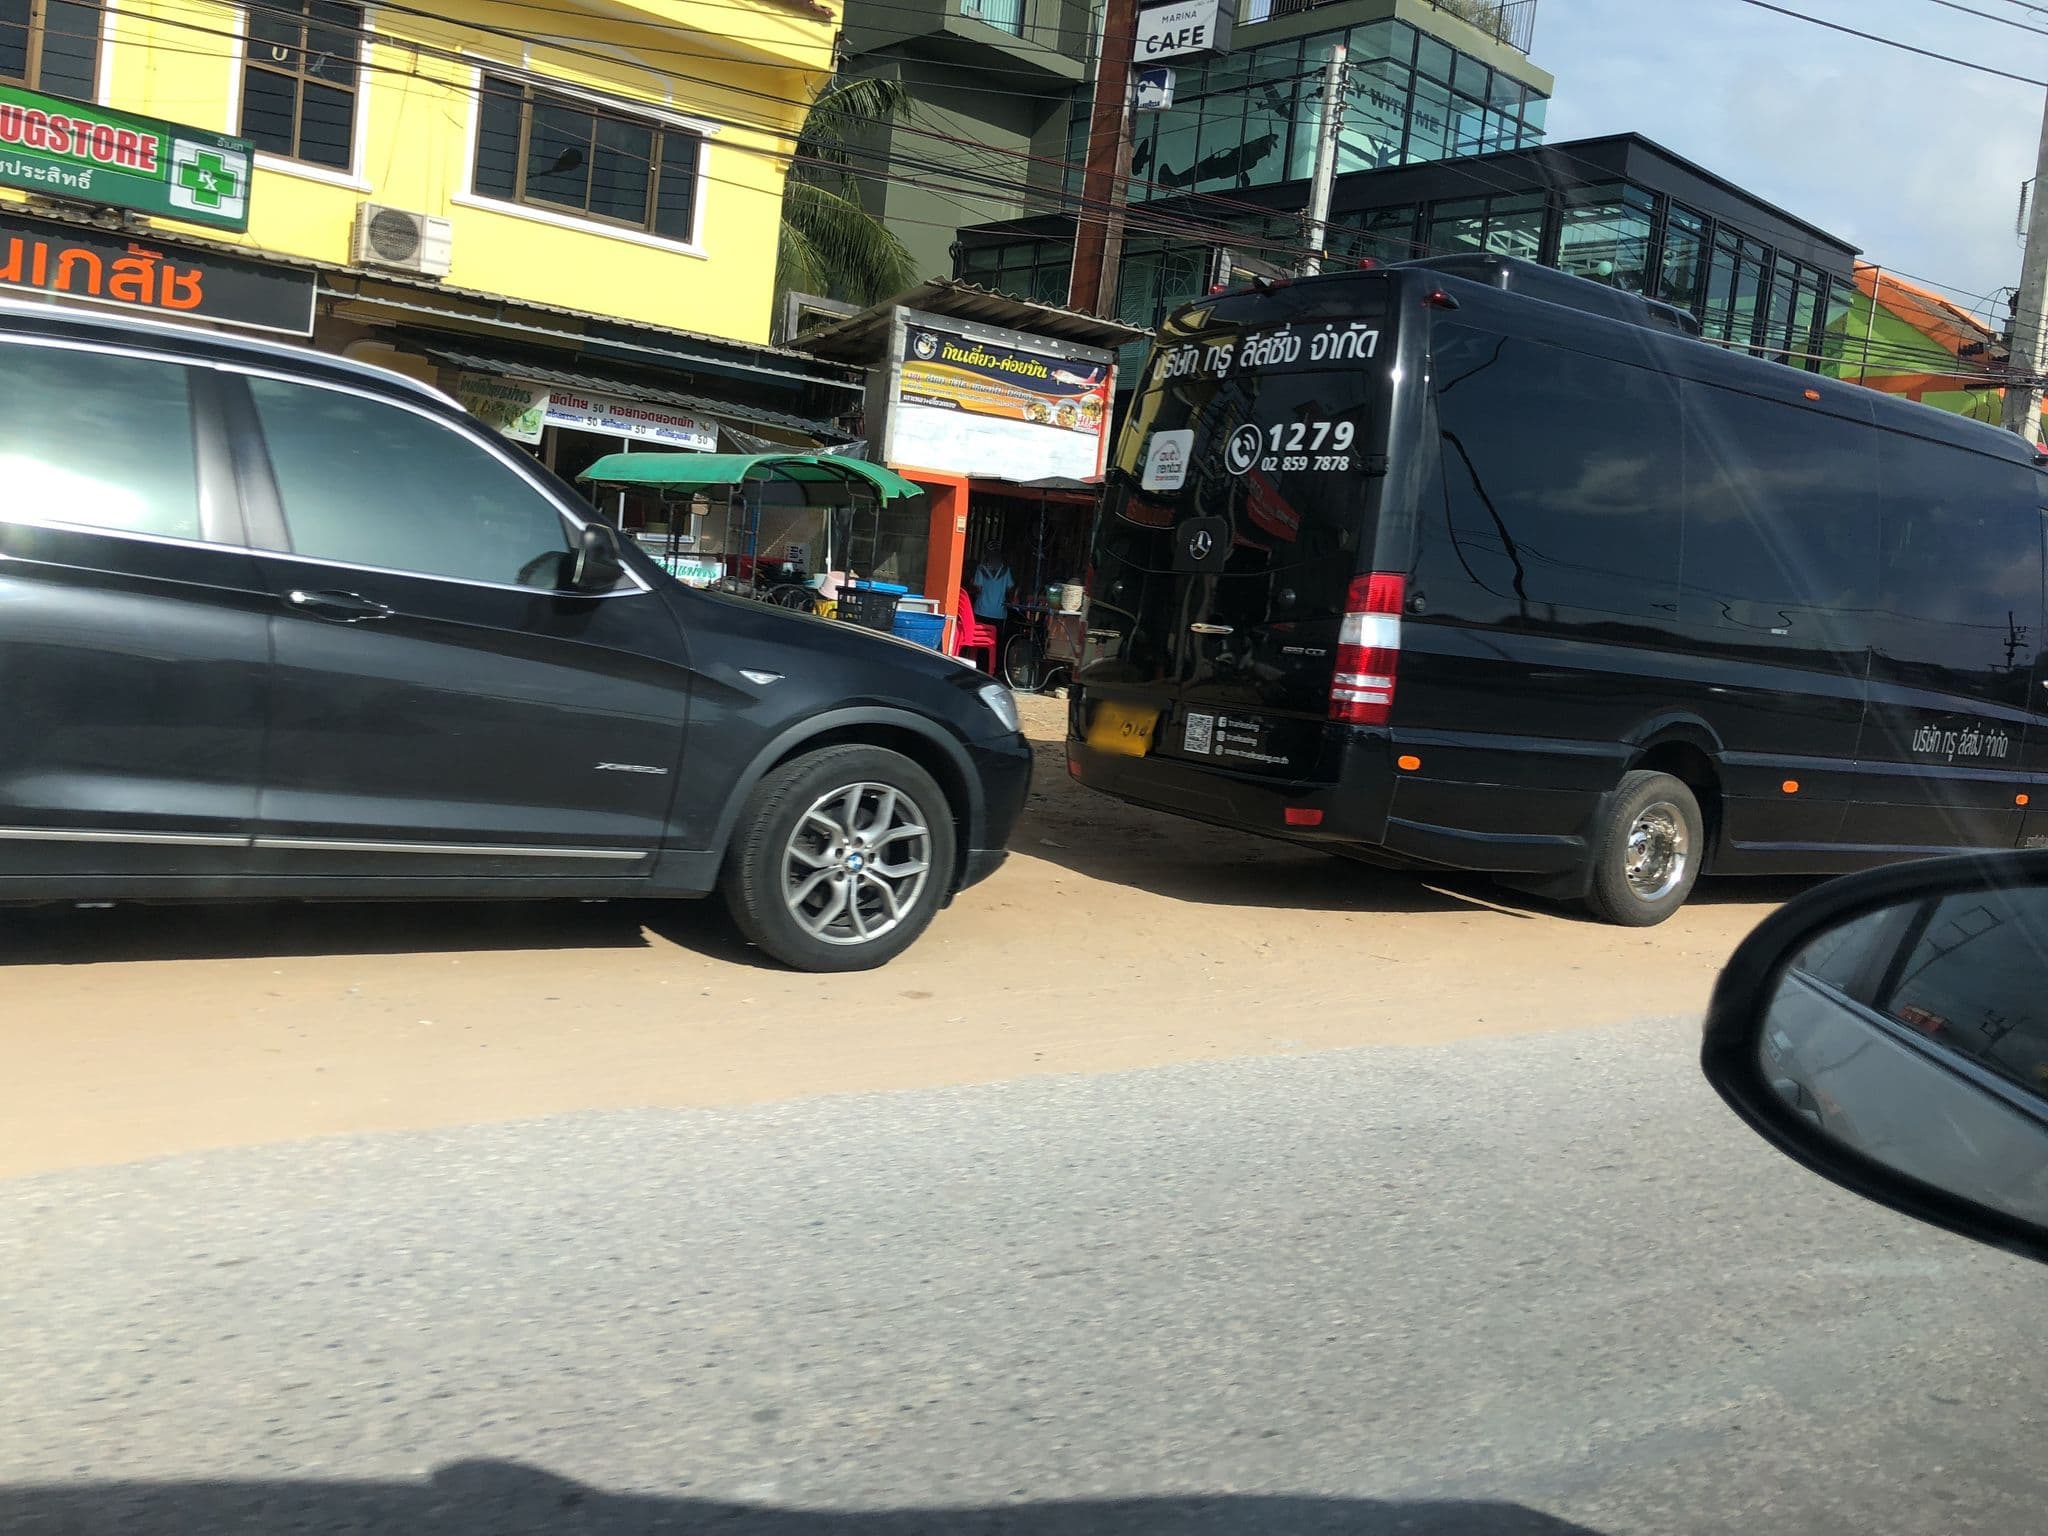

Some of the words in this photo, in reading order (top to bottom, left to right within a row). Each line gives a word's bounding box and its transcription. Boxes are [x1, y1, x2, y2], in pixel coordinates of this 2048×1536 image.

[1161, 10, 1198, 24] MARINA
[1146, 25, 1205, 54] CAFE
[1415, 109, 1440, 134] ME
[0, 103, 159, 173] UGSTORE
[1153, 345, 1200, 380] บริษัท
[1239, 322, 1302, 367] ลีสซิ่ง
[1310, 322, 1379, 361] จำกัด
[592, 403, 604, 413] 50
[586, 416, 598, 427] 50
[634, 424, 646, 434] 50
[697, 434, 708, 445] 50
[1269, 421, 1355, 452] 1279
[1261, 457, 1277, 471] 02
[1282, 456, 1308, 470] 859
[1313, 456, 1350, 471] 7878
